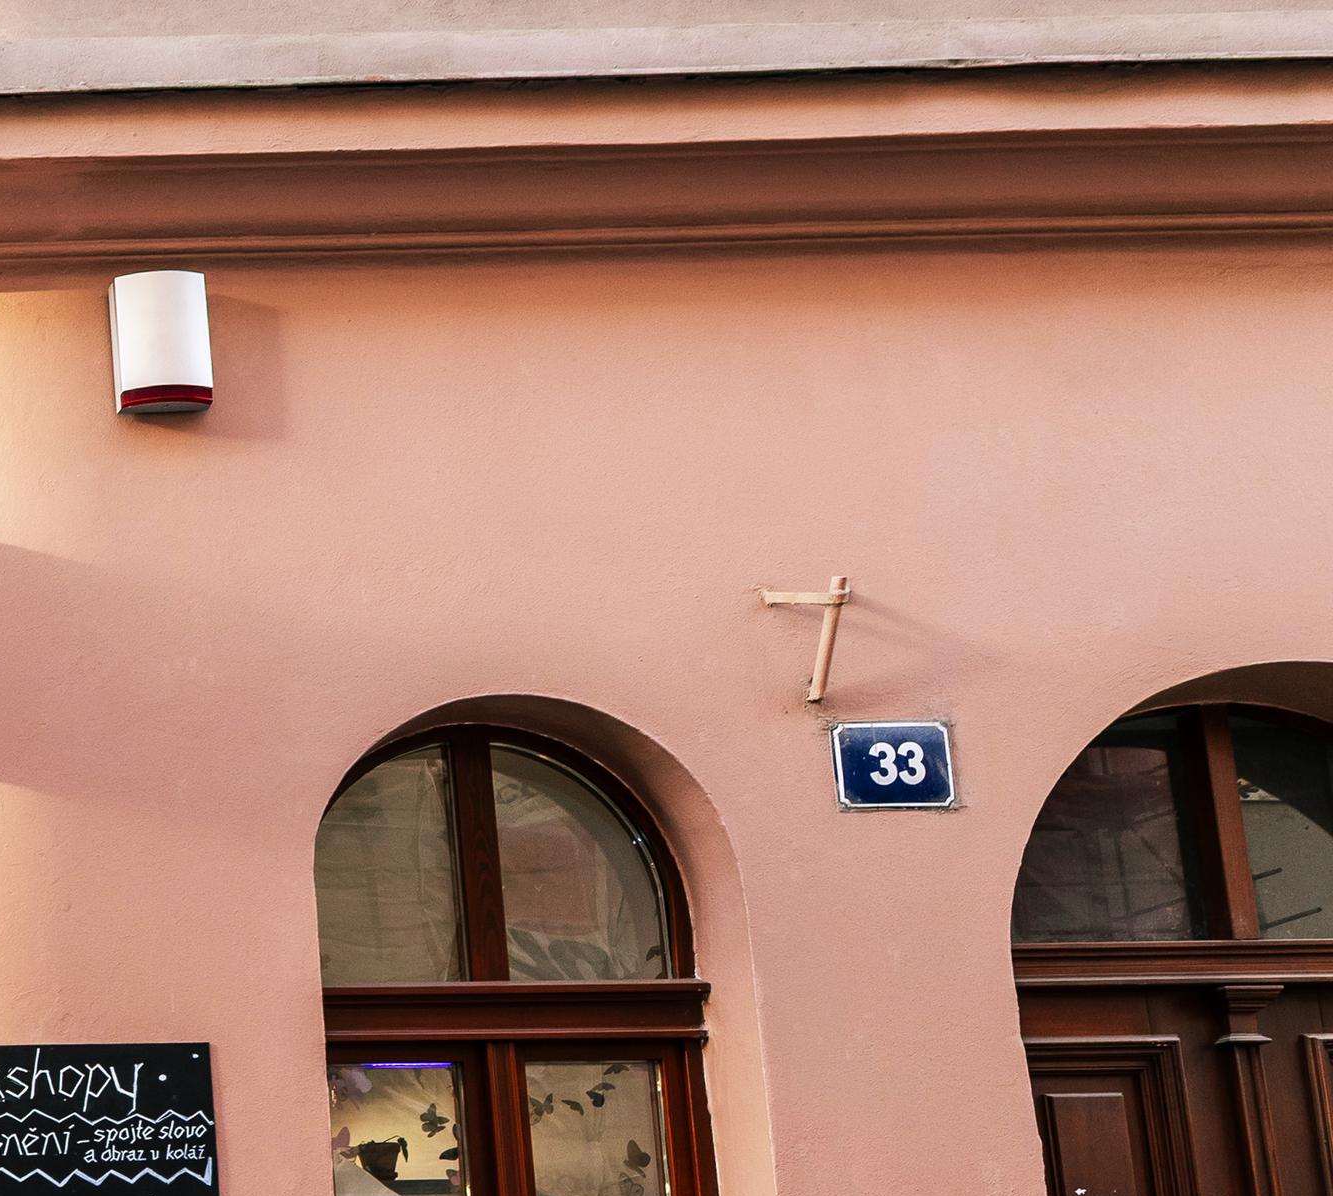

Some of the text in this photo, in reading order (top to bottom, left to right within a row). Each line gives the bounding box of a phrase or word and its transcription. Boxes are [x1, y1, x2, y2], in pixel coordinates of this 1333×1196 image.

[868, 741, 927, 786] 33
[93, 1123, 155, 1146] spojte
[158, 1119, 208, 1141] slovo
[83, 1148, 97, 1164] a
[100, 1144, 147, 1162] obraz
[165, 1143, 206, 1162] koláž
